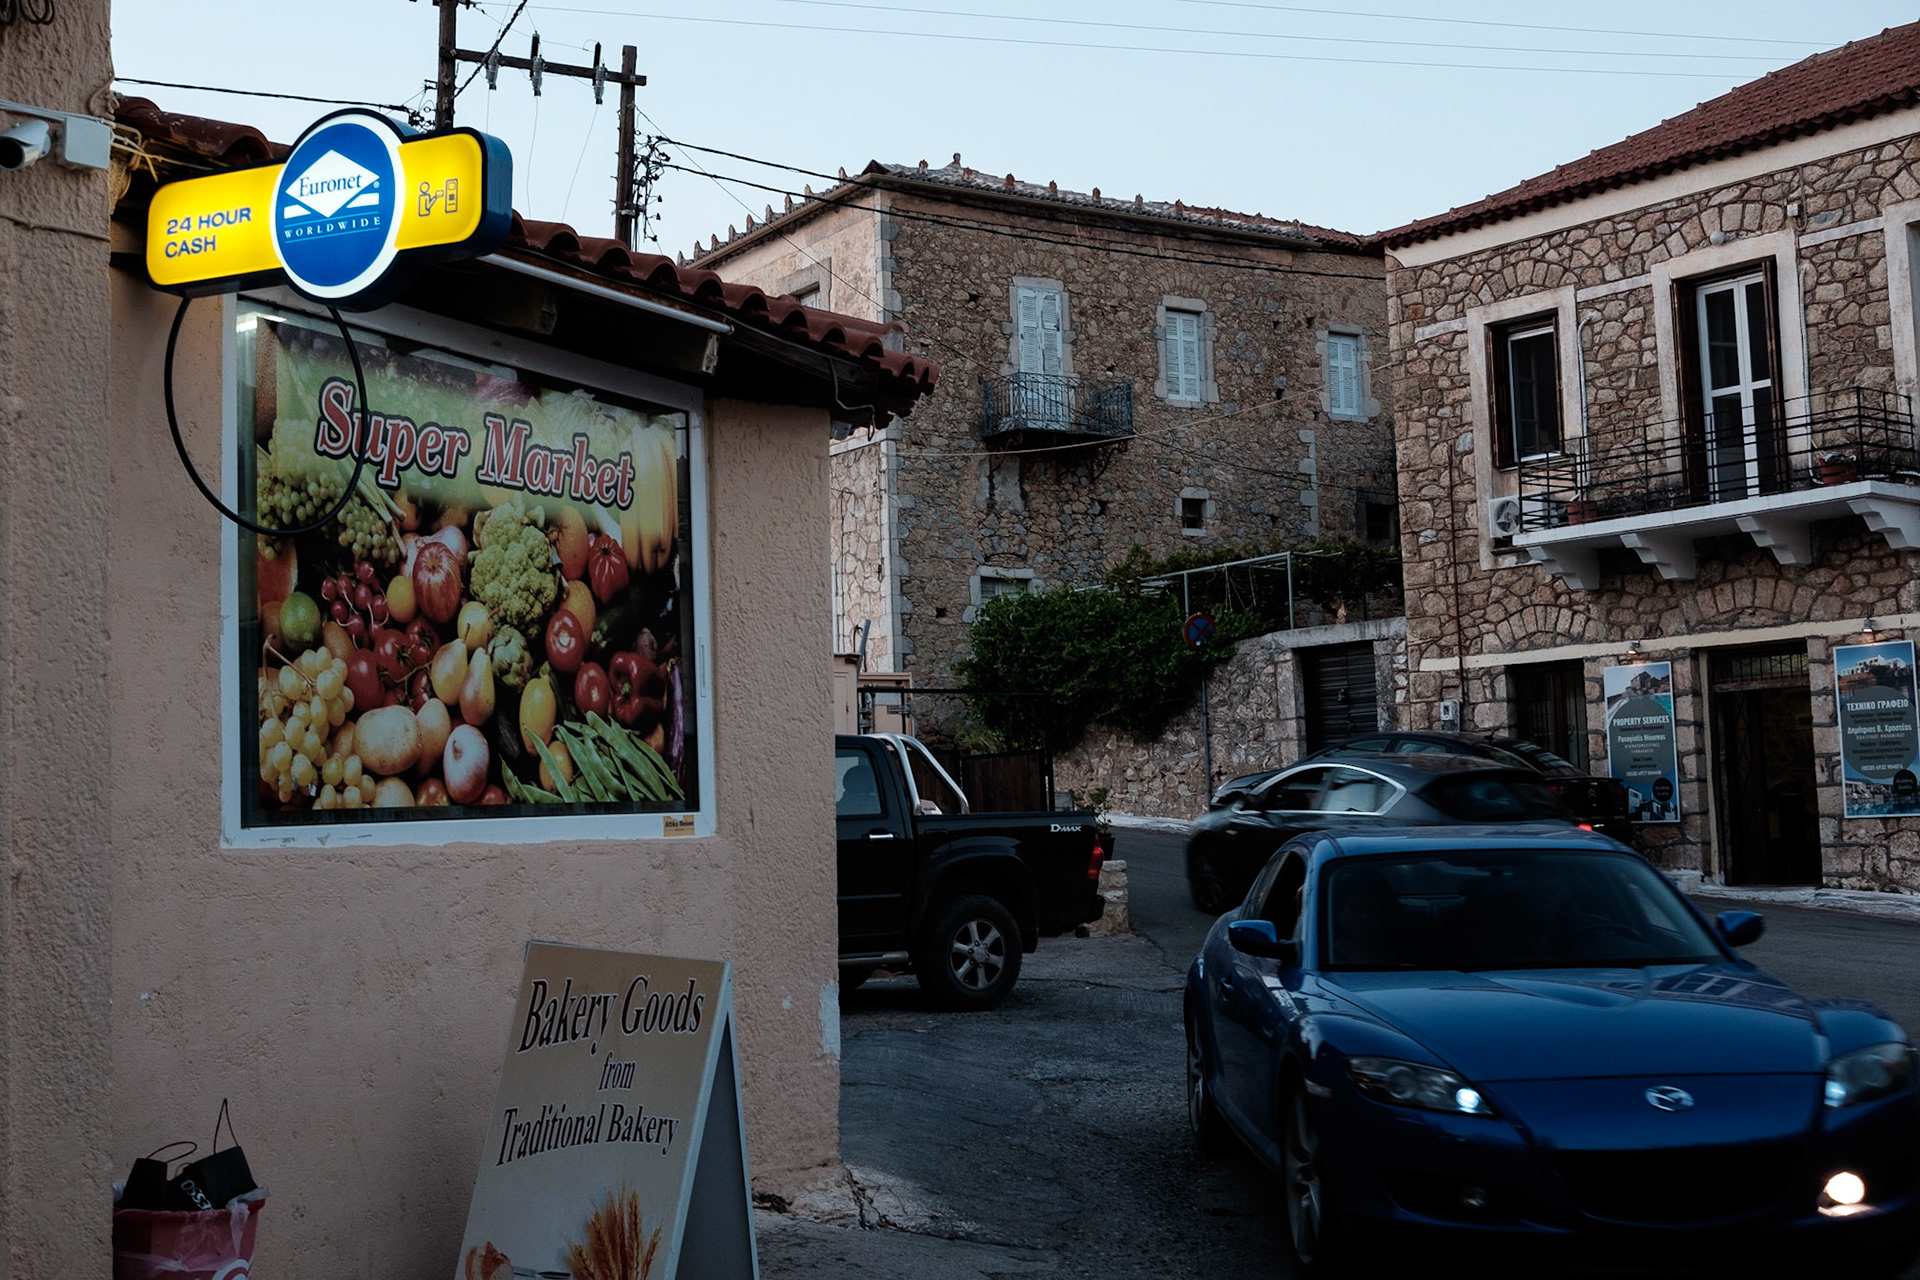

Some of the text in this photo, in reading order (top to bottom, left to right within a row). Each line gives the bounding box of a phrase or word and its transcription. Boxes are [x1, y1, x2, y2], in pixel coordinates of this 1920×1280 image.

[299, 174, 362, 198] Euronet
[166, 207, 251, 235] 24 HOUR
[284, 216, 380, 239] WORLDWIDE
[165, 235, 216, 258] CASH
[315, 378, 635, 508] Super Market
[1846, 699, 1909, 711] ΤΕΧΝΙΚΟ ΓΡΑΦΕΙΟ
[1613, 716, 1670, 726] PROPERTY SERVICES
[517, 975, 705, 1055] Bakery Goods
[597, 1051, 636, 1091] from
[496, 1102, 680, 1167] Traditional Bakery
